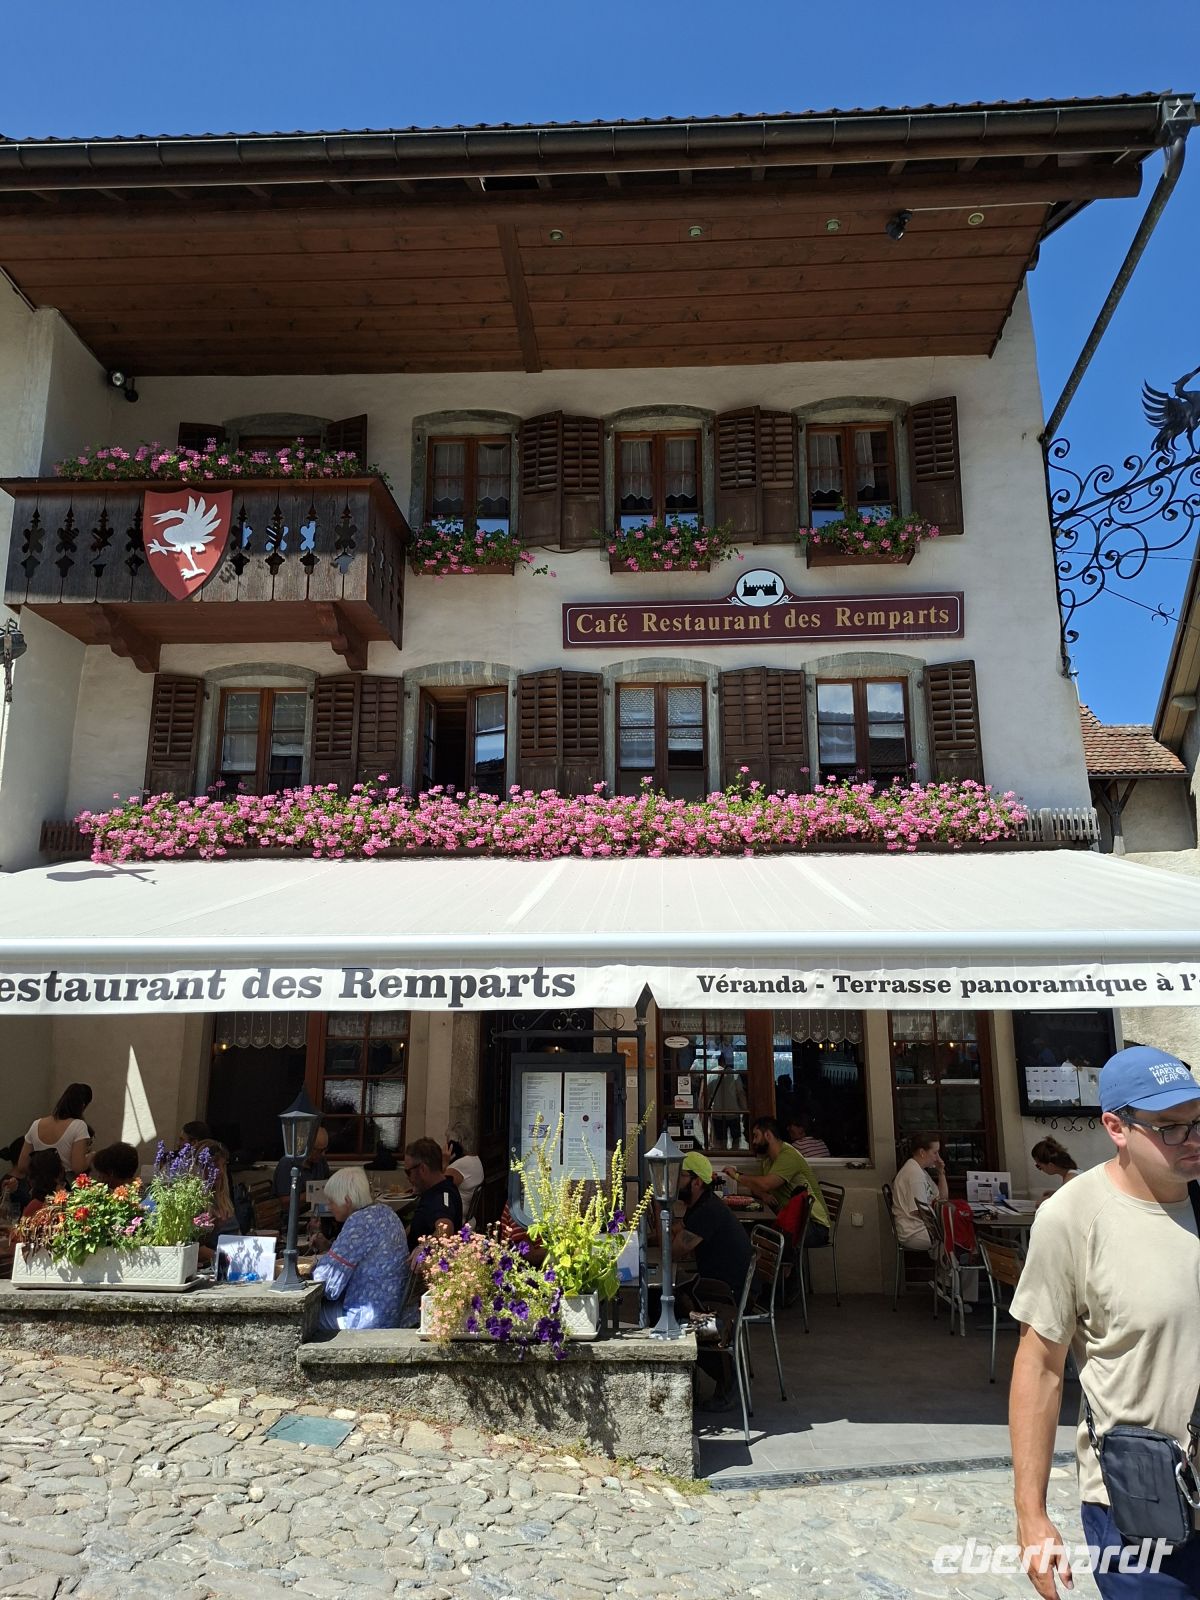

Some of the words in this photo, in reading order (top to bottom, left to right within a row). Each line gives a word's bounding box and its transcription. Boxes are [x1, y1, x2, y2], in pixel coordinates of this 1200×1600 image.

[576, 613, 628, 633] Café
[642, 611, 771, 632] Restaurant
[784, 608, 821, 628] des
[835, 605, 950, 630] Remparts
[0, 969, 225, 1002] estaurant
[242, 967, 322, 1000] des
[338, 966, 577, 1007] Remparts
[696, 973, 808, 994] Véranda
[832, 974, 952, 994] Terrasse
[960, 972, 1147, 998] panoramique
[1156, 972, 1174, 991] à
[1179, 973, 1200, 991] l'
[1151, 1066, 1175, 1078] HARD
[1156, 1073, 1180, 1085] WEAR
